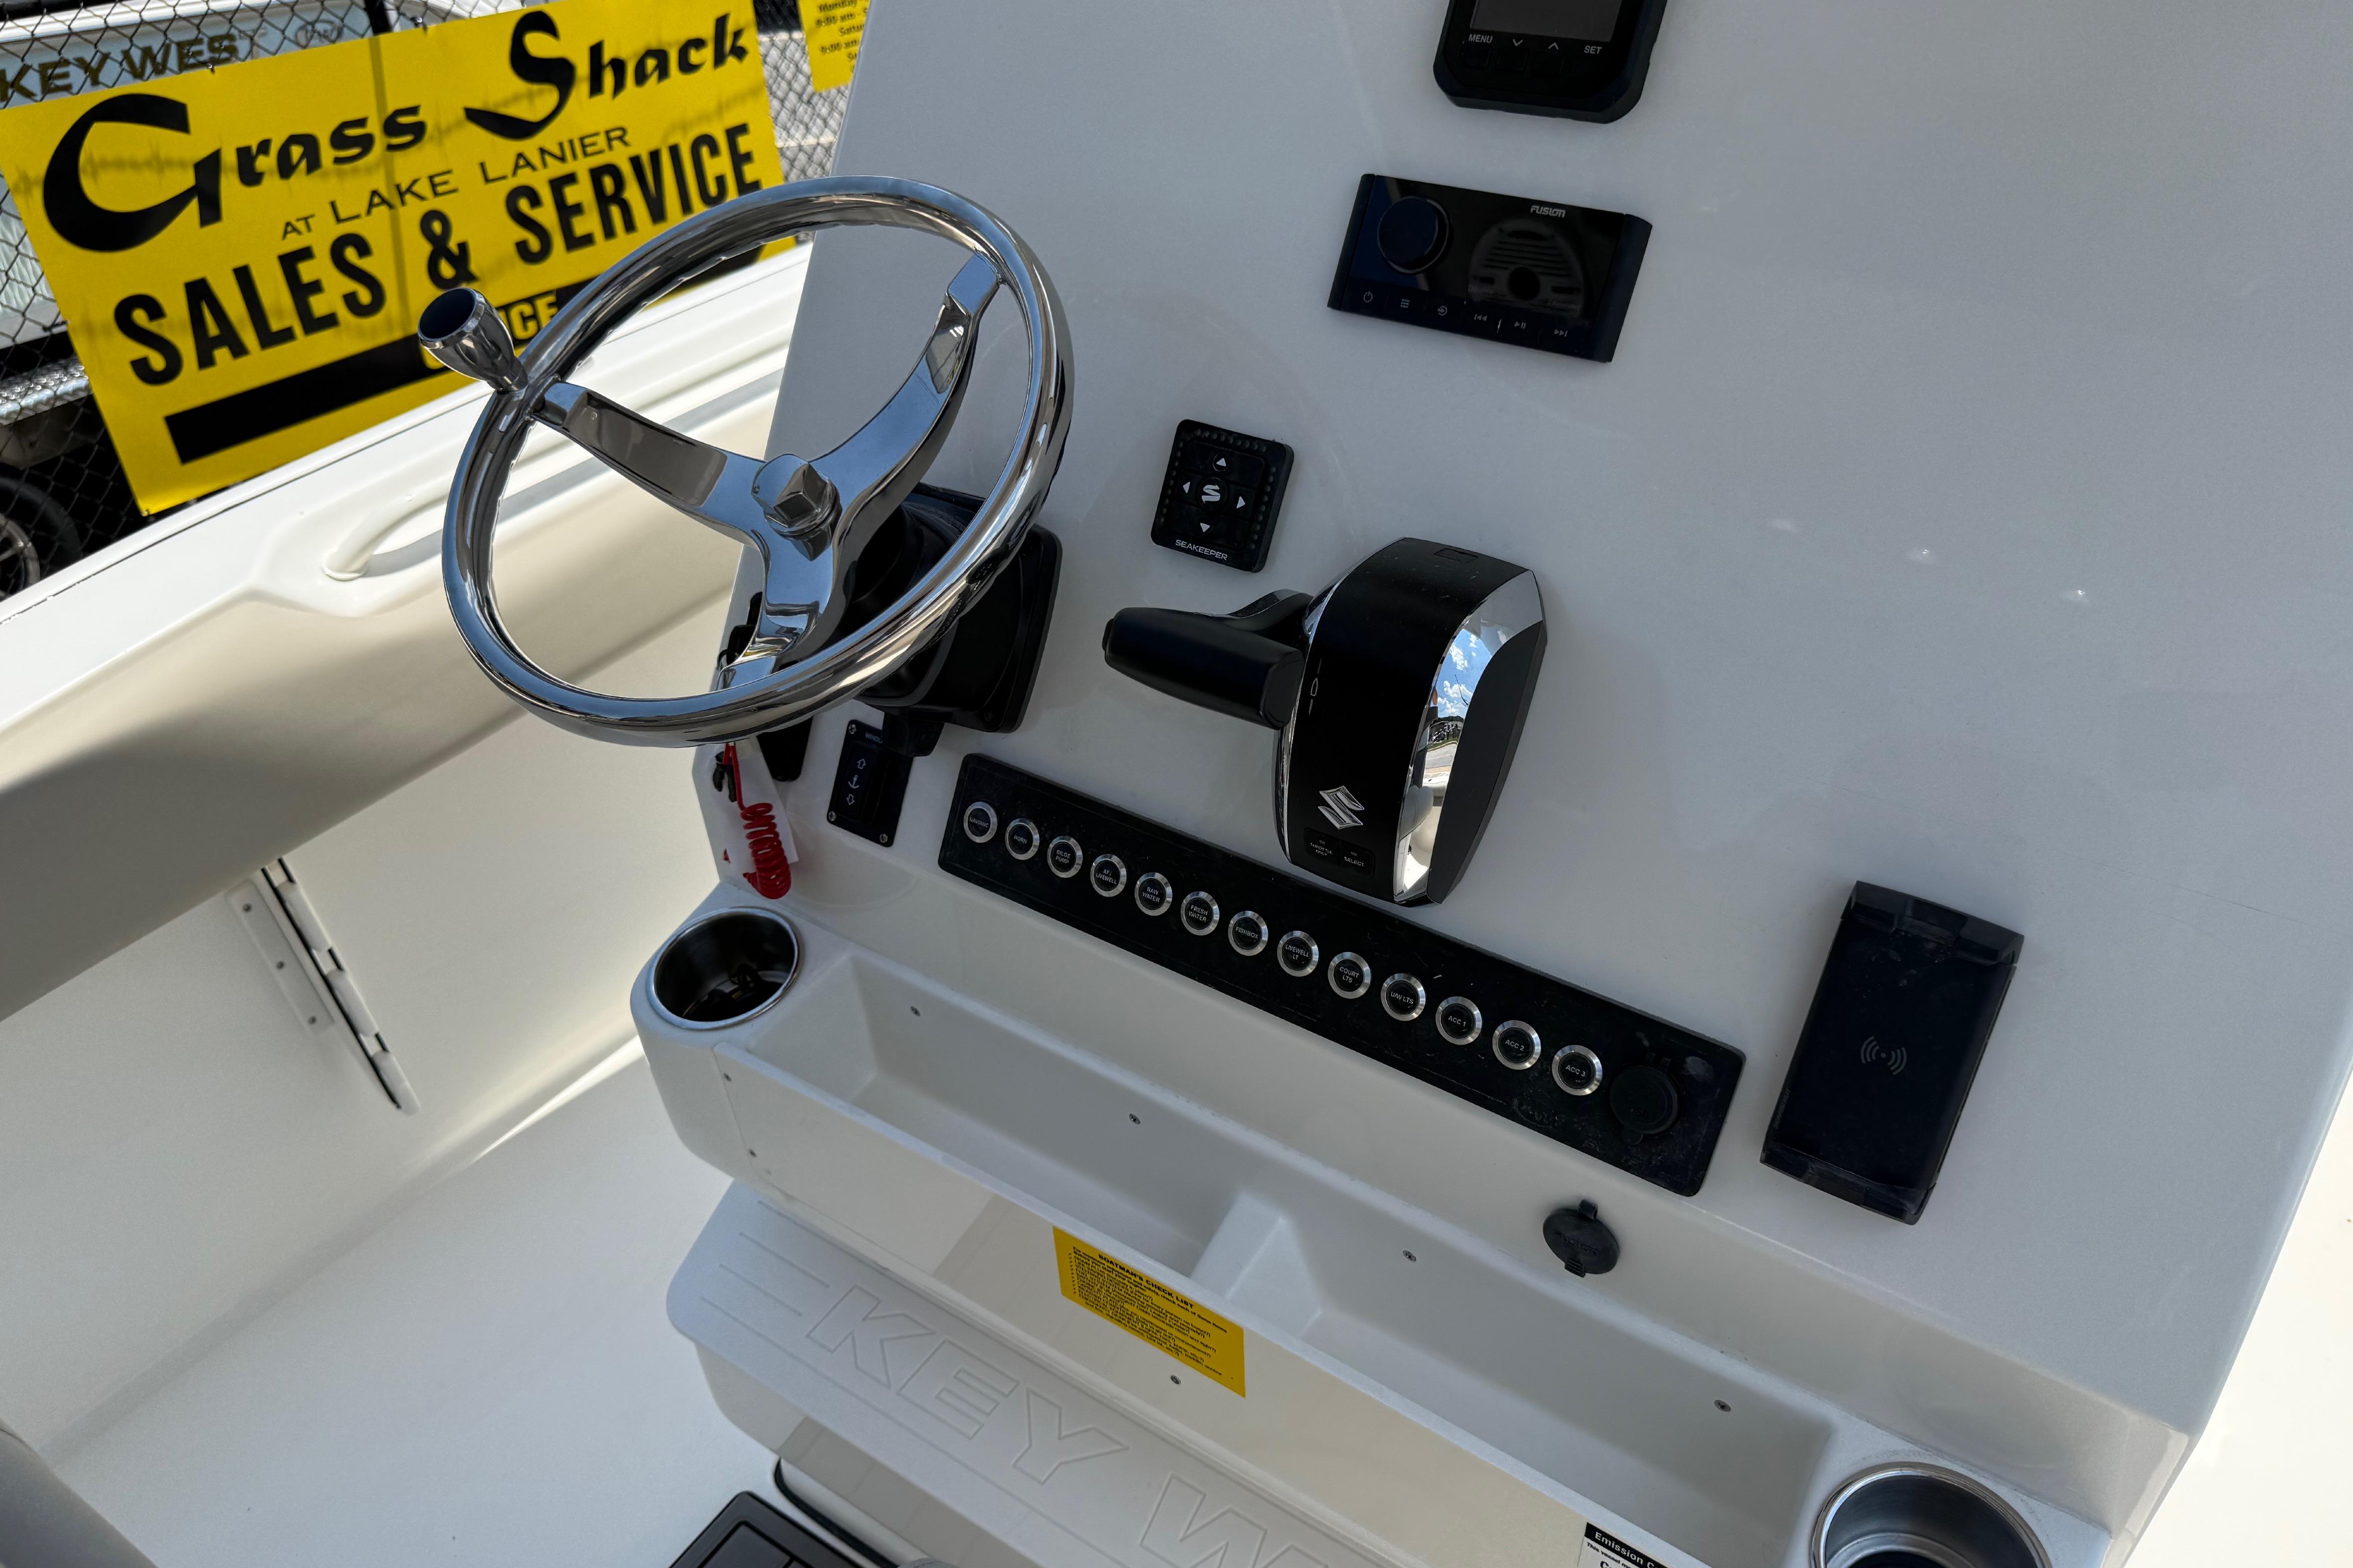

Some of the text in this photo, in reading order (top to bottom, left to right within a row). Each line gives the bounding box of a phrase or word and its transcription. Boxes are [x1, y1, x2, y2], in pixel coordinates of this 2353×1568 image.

[1468, 34, 1493, 44] MENU
[1584, 45, 1602, 55] SET
[43, 11, 748, 252] Grass Shack
[282, 126, 631, 240] AT LAKE LANIER
[1530, 204, 1566, 218] FUSION
[114, 123, 762, 385] SALES & SERVICE
[1175, 539, 1228, 561] SEAKEEPER
[865, 732, 883, 744] WINDL
[1014, 834, 1027, 844] HORN
[1056, 849, 1071, 859] BILGE
[1055, 855, 1070, 865] PUMP
[1344, 856, 1365, 867] SELECT
[1096, 872, 1117, 884] LIVEWELL
[1146, 886, 1159, 895] RAW
[1142, 892, 1161, 903] WATER
[1190, 905, 1209, 916] FRESH
[1188, 911, 1208, 923] WATER
[1235, 926, 1259, 940] FISHBOX
[1285, 944, 1310, 958] LIVEWELL
[1339, 967, 1360, 978] COURT
[1342, 975, 1353, 984] LTS
[1403, 996, 1414, 1005] LTS
[1448, 1014, 1462, 1026] ACC
[1505, 1038, 1519, 1049] ACC
[1566, 1064, 1580, 1075] ACC
[1098, 1253, 1194, 1309] BOATMAN'S CHECK LIST
[805, 1283, 1129, 1485] KEY
[1595, 1532, 1643, 1565] Emission
